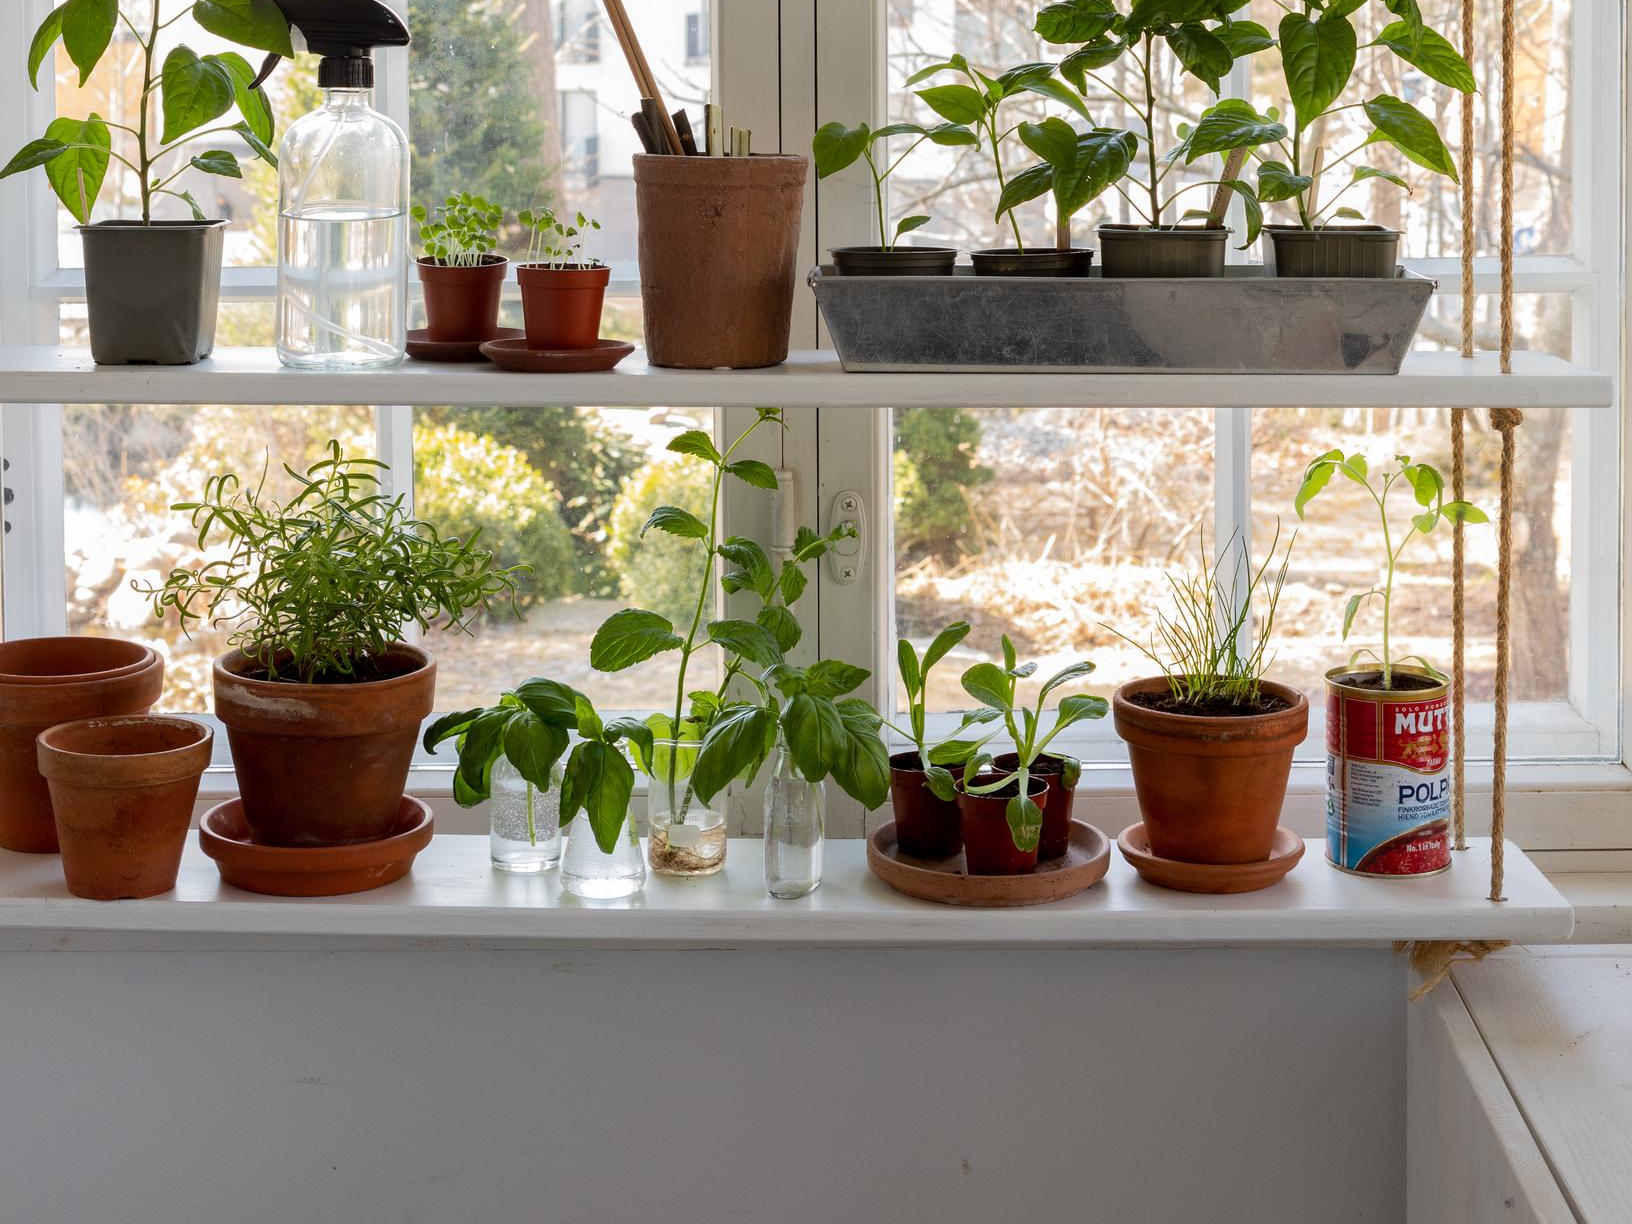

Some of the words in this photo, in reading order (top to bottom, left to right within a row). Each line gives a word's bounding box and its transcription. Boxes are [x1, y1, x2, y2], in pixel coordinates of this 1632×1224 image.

[1398, 777, 1450, 805] POLP
[1406, 844, 1418, 852] No.
[1422, 843, 1429, 851] in
